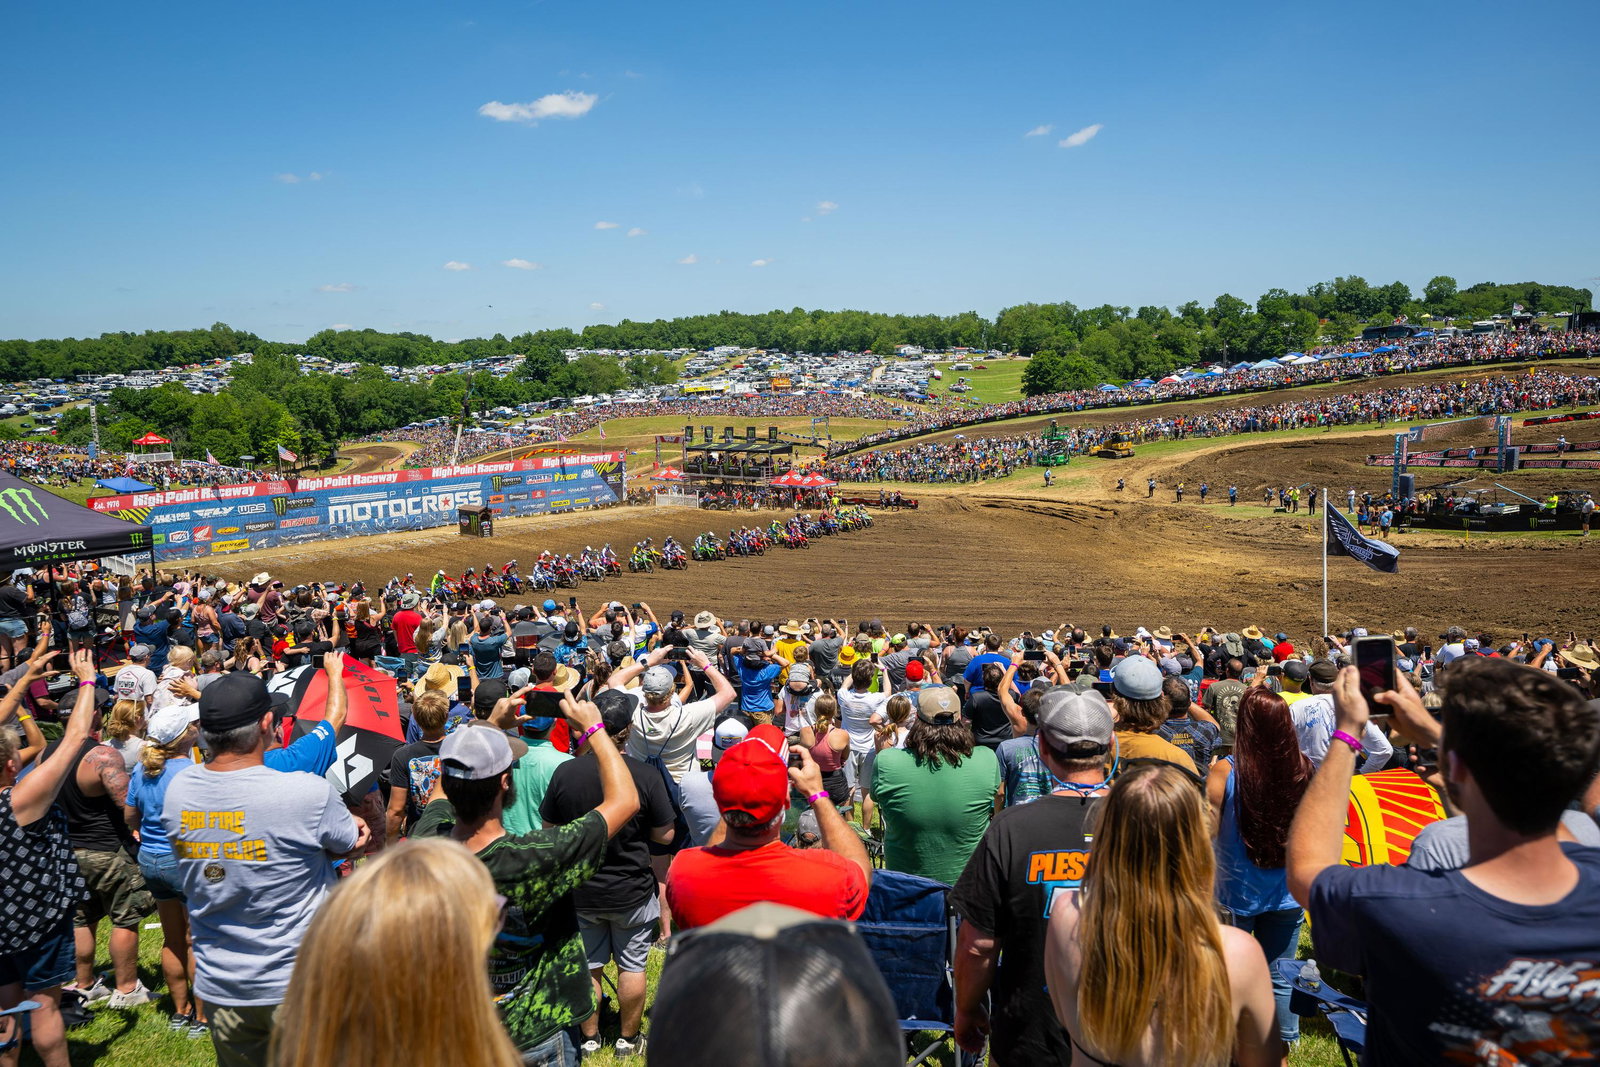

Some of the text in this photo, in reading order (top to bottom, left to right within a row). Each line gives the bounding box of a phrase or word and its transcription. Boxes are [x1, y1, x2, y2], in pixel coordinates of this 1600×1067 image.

[542, 458, 560, 467] High
[561, 456, 580, 465] Point
[580, 454, 612, 463] Raceway
[432, 466, 452, 478] High
[453, 464, 477, 476] Point
[478, 462, 514, 474] Raceway
[298, 478, 322, 490] High
[324, 475, 351, 488] Point
[354, 472, 398, 485] Raceway
[133, 494, 164, 507] High
[165, 490, 199, 503] Point
[390, 487, 429, 498] PRO
[238, 504, 266, 514] WPS
[328, 490, 482, 524] MOTOCROSS
[330, 511, 460, 532] CHAMPIONS
[14, 540, 86, 556] MONSTER
[26, 552, 76, 562] ENERGY
[180, 810, 245, 835] PGH FIRE
[223, 839, 268, 861] CLUB
